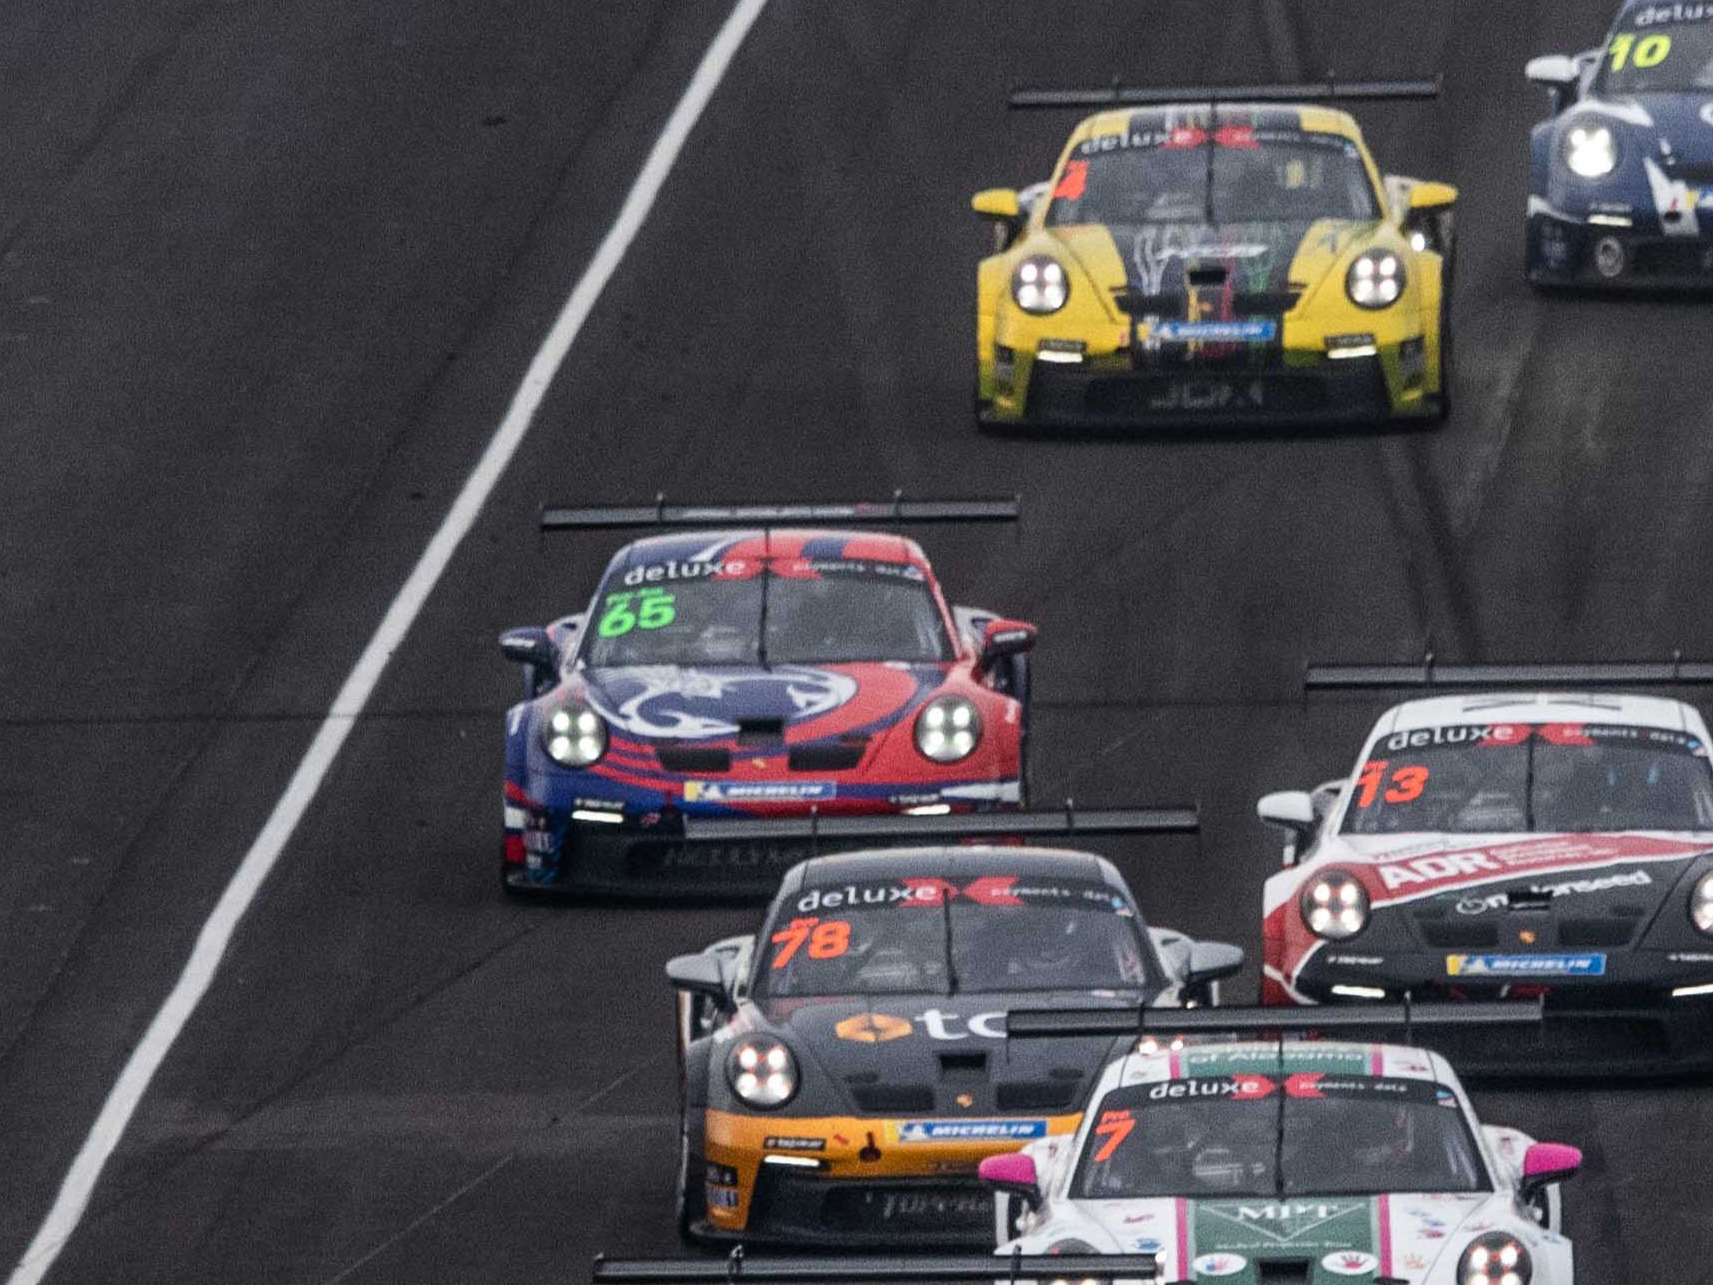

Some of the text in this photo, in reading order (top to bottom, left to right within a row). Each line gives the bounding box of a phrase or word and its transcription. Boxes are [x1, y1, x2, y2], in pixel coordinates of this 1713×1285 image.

[1608, 34, 1672, 72] 10
[623, 560, 746, 586] deluxe
[598, 595, 676, 638] 65
[1387, 726, 1514, 751] deluxe
[1355, 764, 1429, 809] 13
[1377, 850, 1502, 891] ADR
[797, 883, 937, 913] deluxe
[772, 921, 853, 970] 78
[1490, 957, 1592, 972] MICHELIN
[1149, 1081, 1260, 1100] deluxe
[932, 1124, 1036, 1137] MICHELIN
[1095, 1120, 1137, 1162] 7
